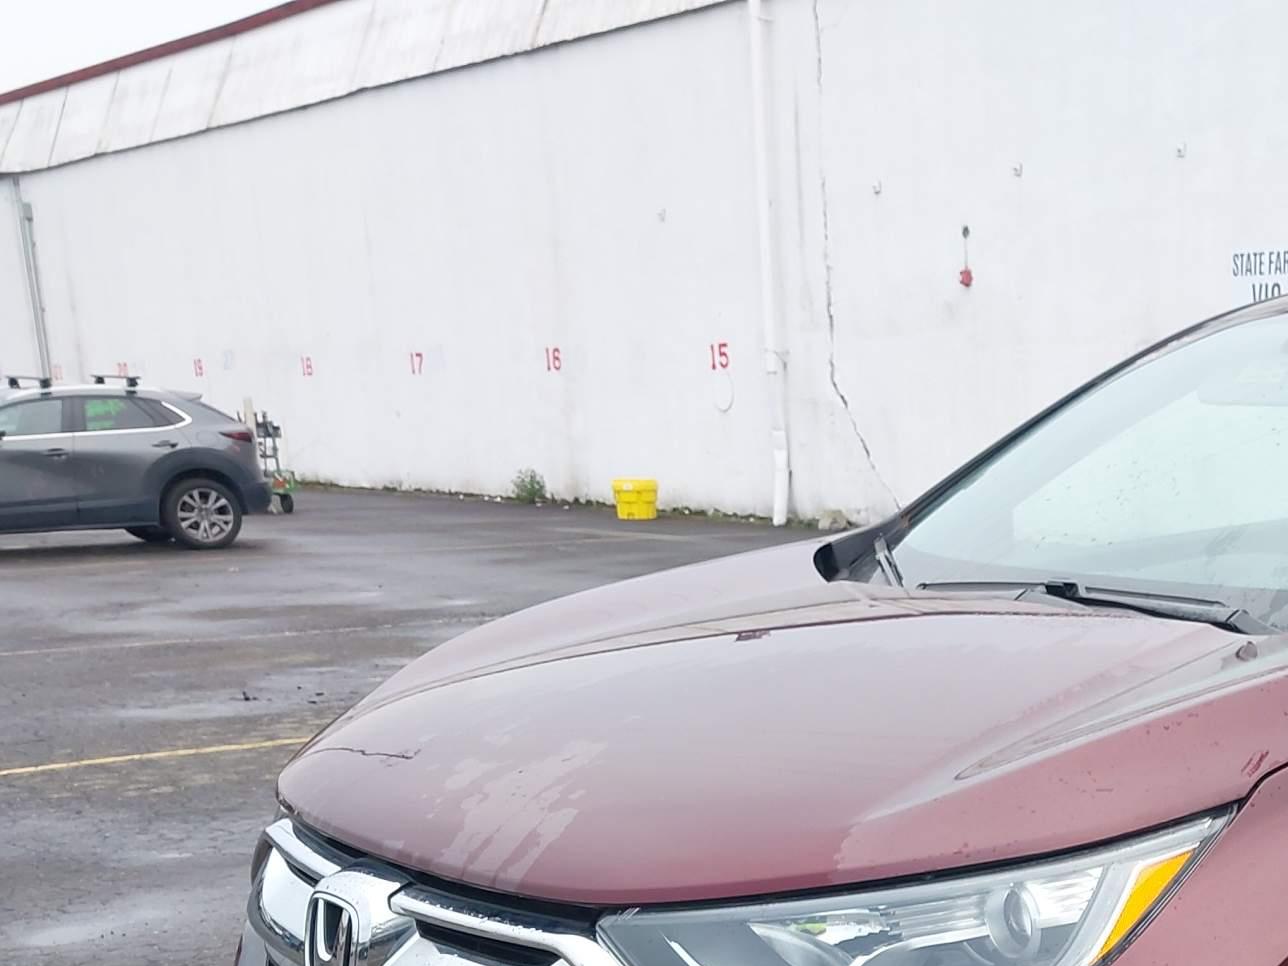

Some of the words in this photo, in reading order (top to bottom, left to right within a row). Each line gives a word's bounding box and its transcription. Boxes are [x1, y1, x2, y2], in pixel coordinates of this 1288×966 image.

[1232, 251, 1265, 277] STATE
[301, 356, 314, 377] 18
[410, 352, 424, 375] 17
[545, 347, 562, 372] 16
[710, 342, 730, 371] 15
